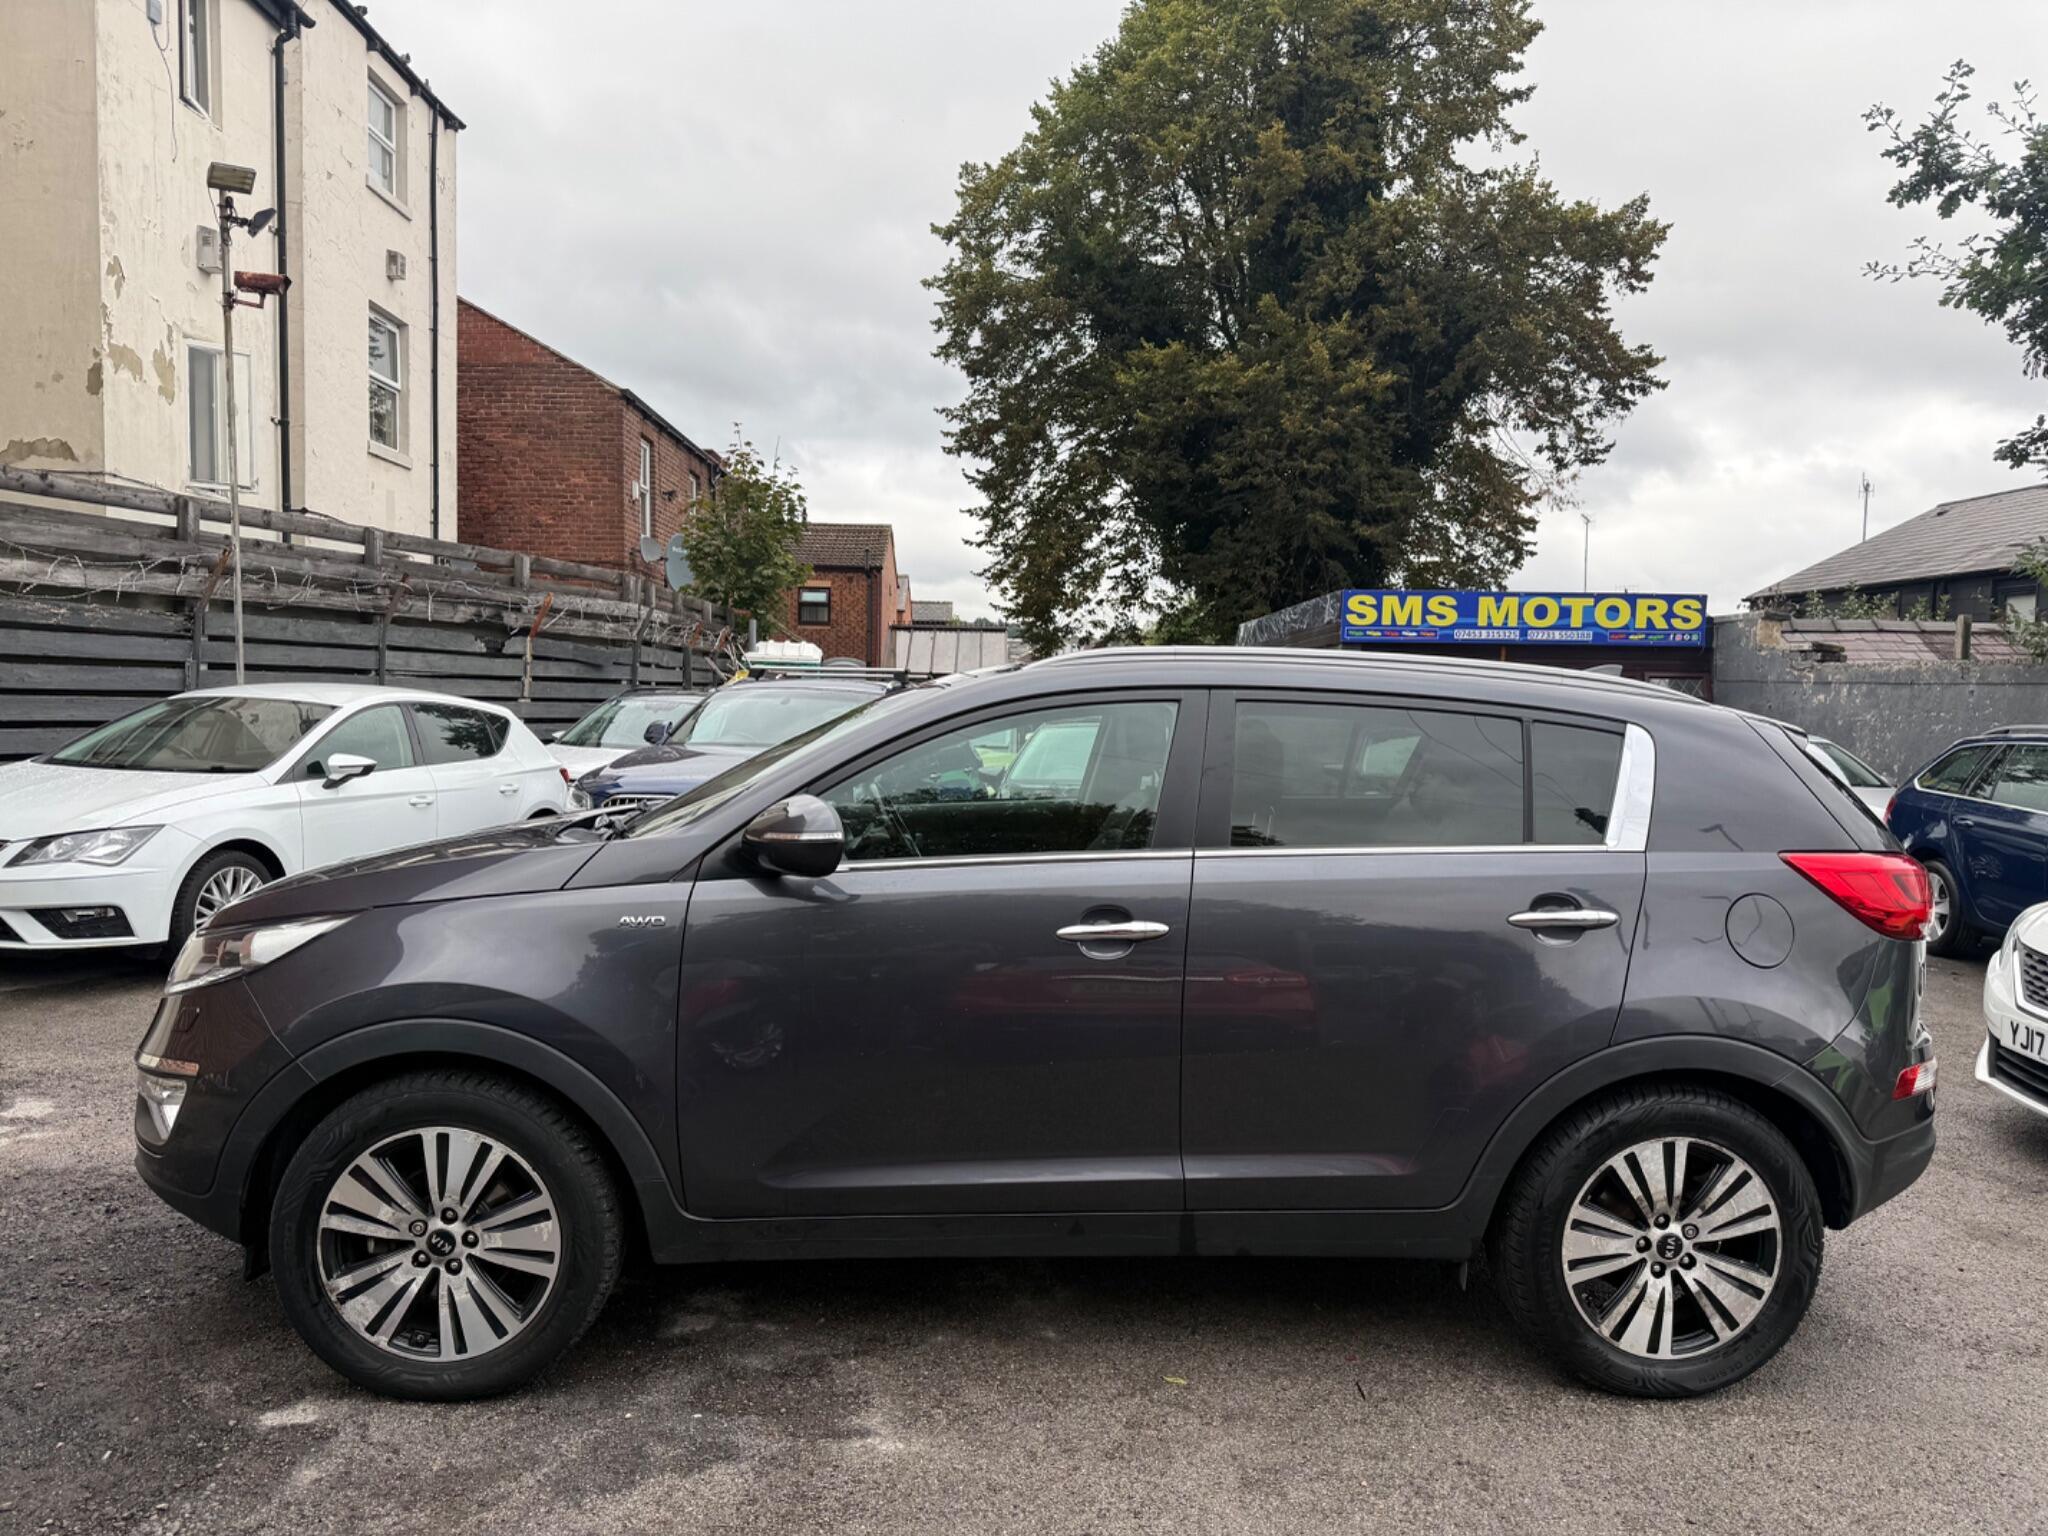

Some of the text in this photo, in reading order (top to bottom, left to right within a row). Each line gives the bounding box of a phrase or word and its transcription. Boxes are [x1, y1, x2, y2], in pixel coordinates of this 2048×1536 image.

[1346, 594, 1703, 630] SMS MOTORS
[617, 915, 666, 928] AWD
[2010, 1020, 2045, 1056] YJ17
[431, 1233, 452, 1253] KIA
[1664, 1236, 1677, 1258] KIA
